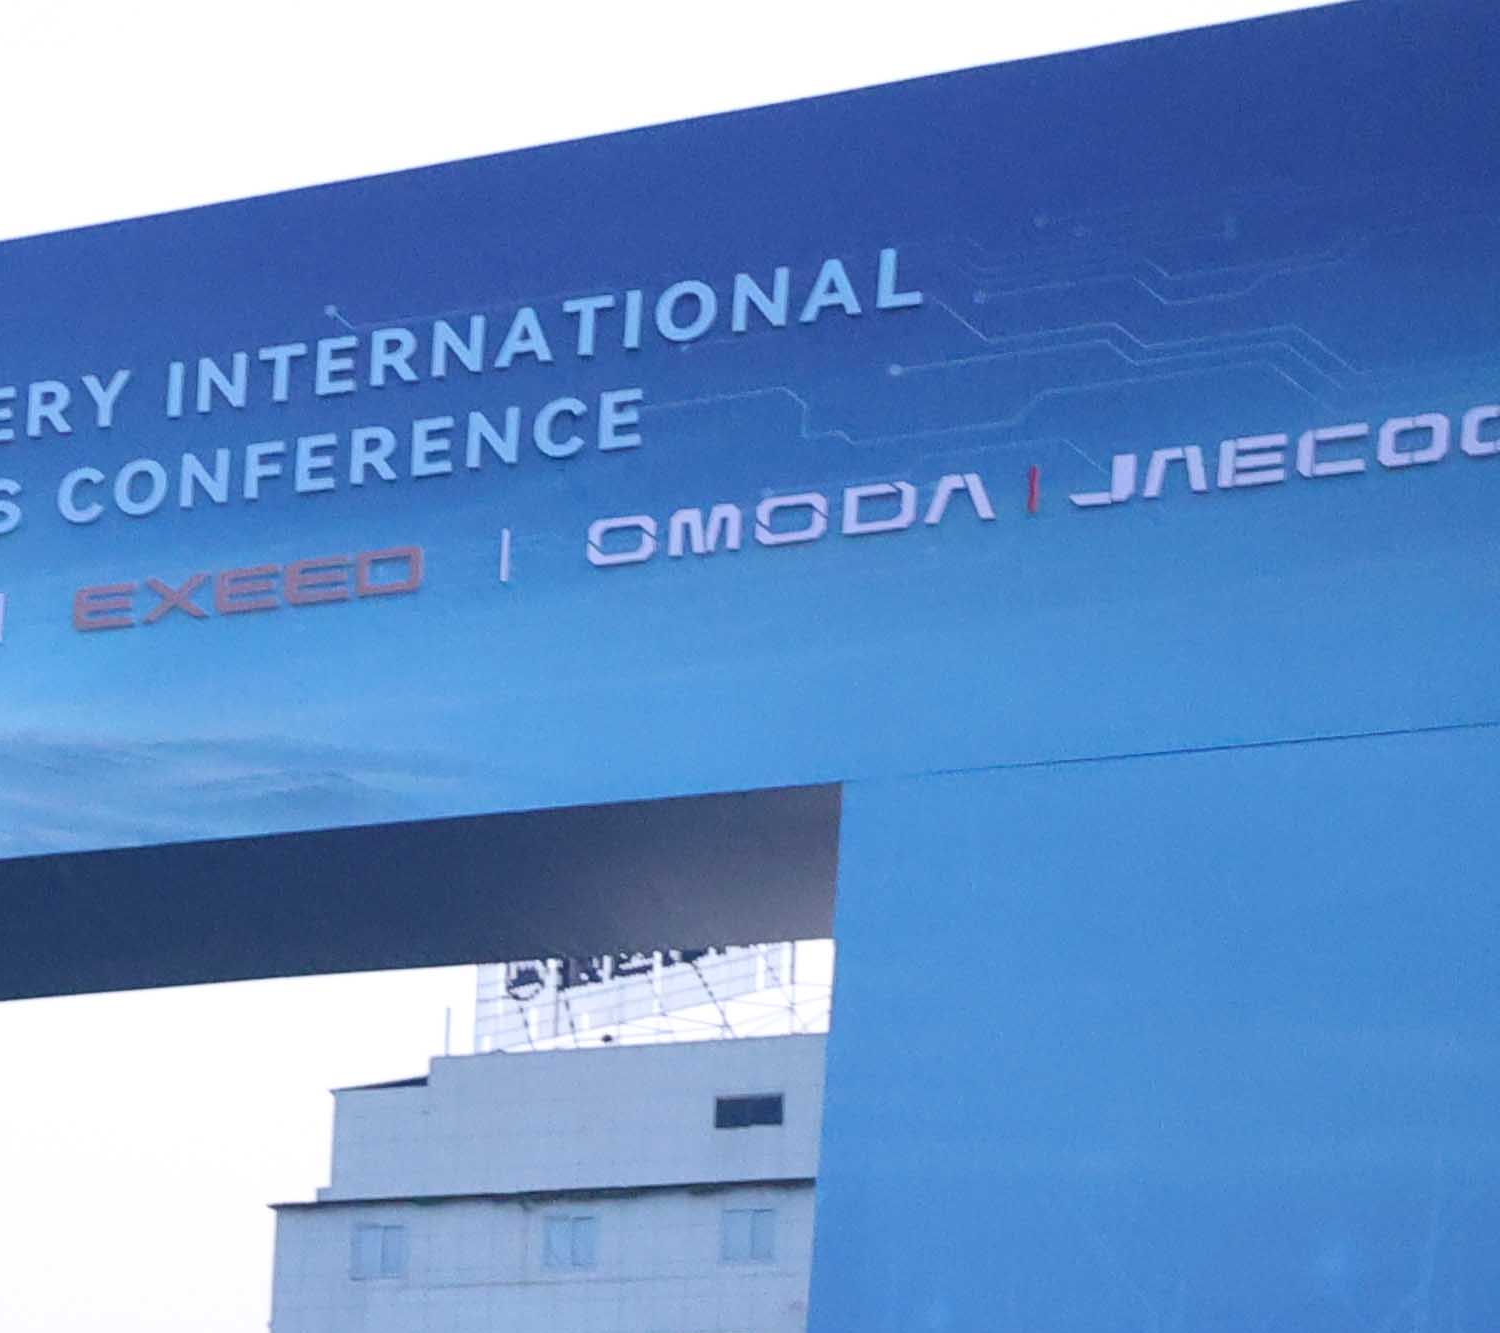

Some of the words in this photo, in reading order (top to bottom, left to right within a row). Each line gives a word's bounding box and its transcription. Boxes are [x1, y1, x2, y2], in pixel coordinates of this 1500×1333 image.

[165, 245, 926, 418] INTERNATIONAL
[56, 384, 648, 526] CONFERENCE
[70, 543, 428, 634] EXEED
[584, 470, 998, 571] OMODA
